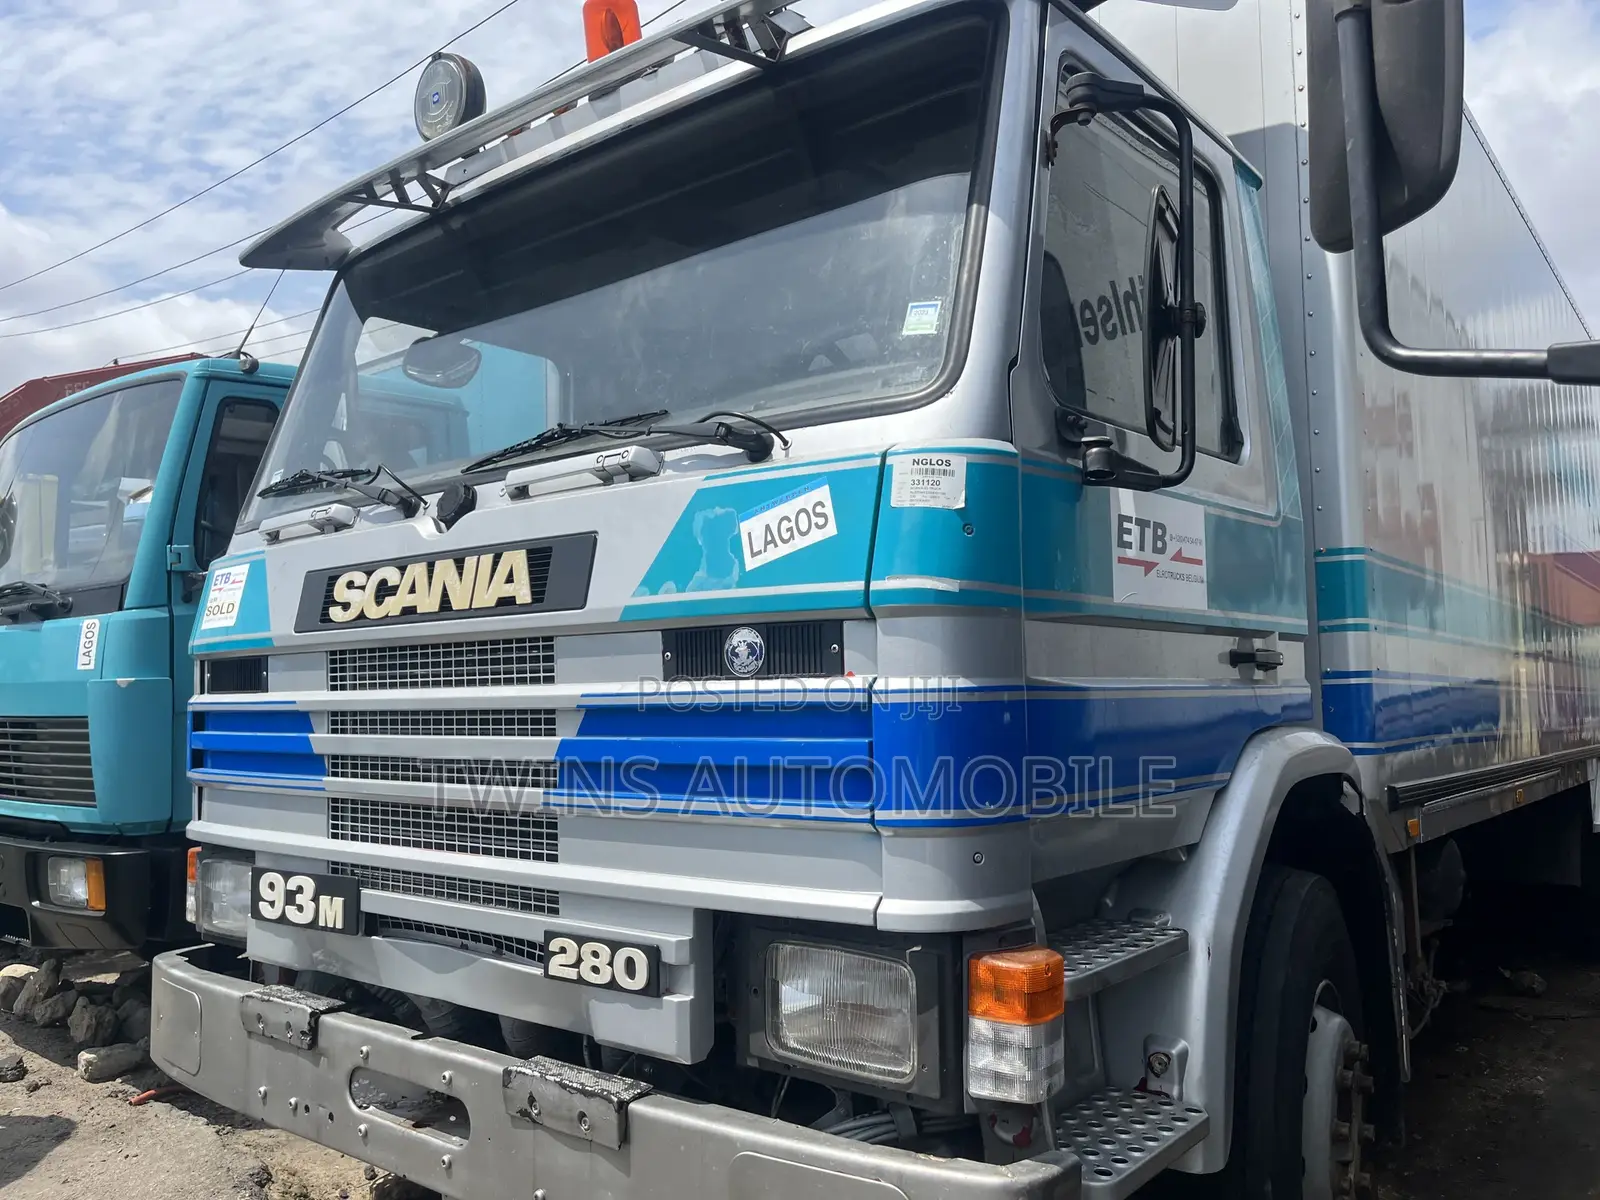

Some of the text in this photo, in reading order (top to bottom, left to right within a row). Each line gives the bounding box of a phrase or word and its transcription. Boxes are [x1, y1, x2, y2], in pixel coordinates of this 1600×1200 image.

[910, 479, 941, 487] 331120
[912, 458, 952, 467] NGLOS
[747, 500, 829, 559] LAGOS
[1116, 513, 1168, 556] ETB
[213, 571, 232, 587] ETB
[327, 548, 533, 623] SCANIA
[205, 602, 235, 617] SOLD
[81, 621, 97, 666] LAGOS
[547, 937, 651, 991] 280
